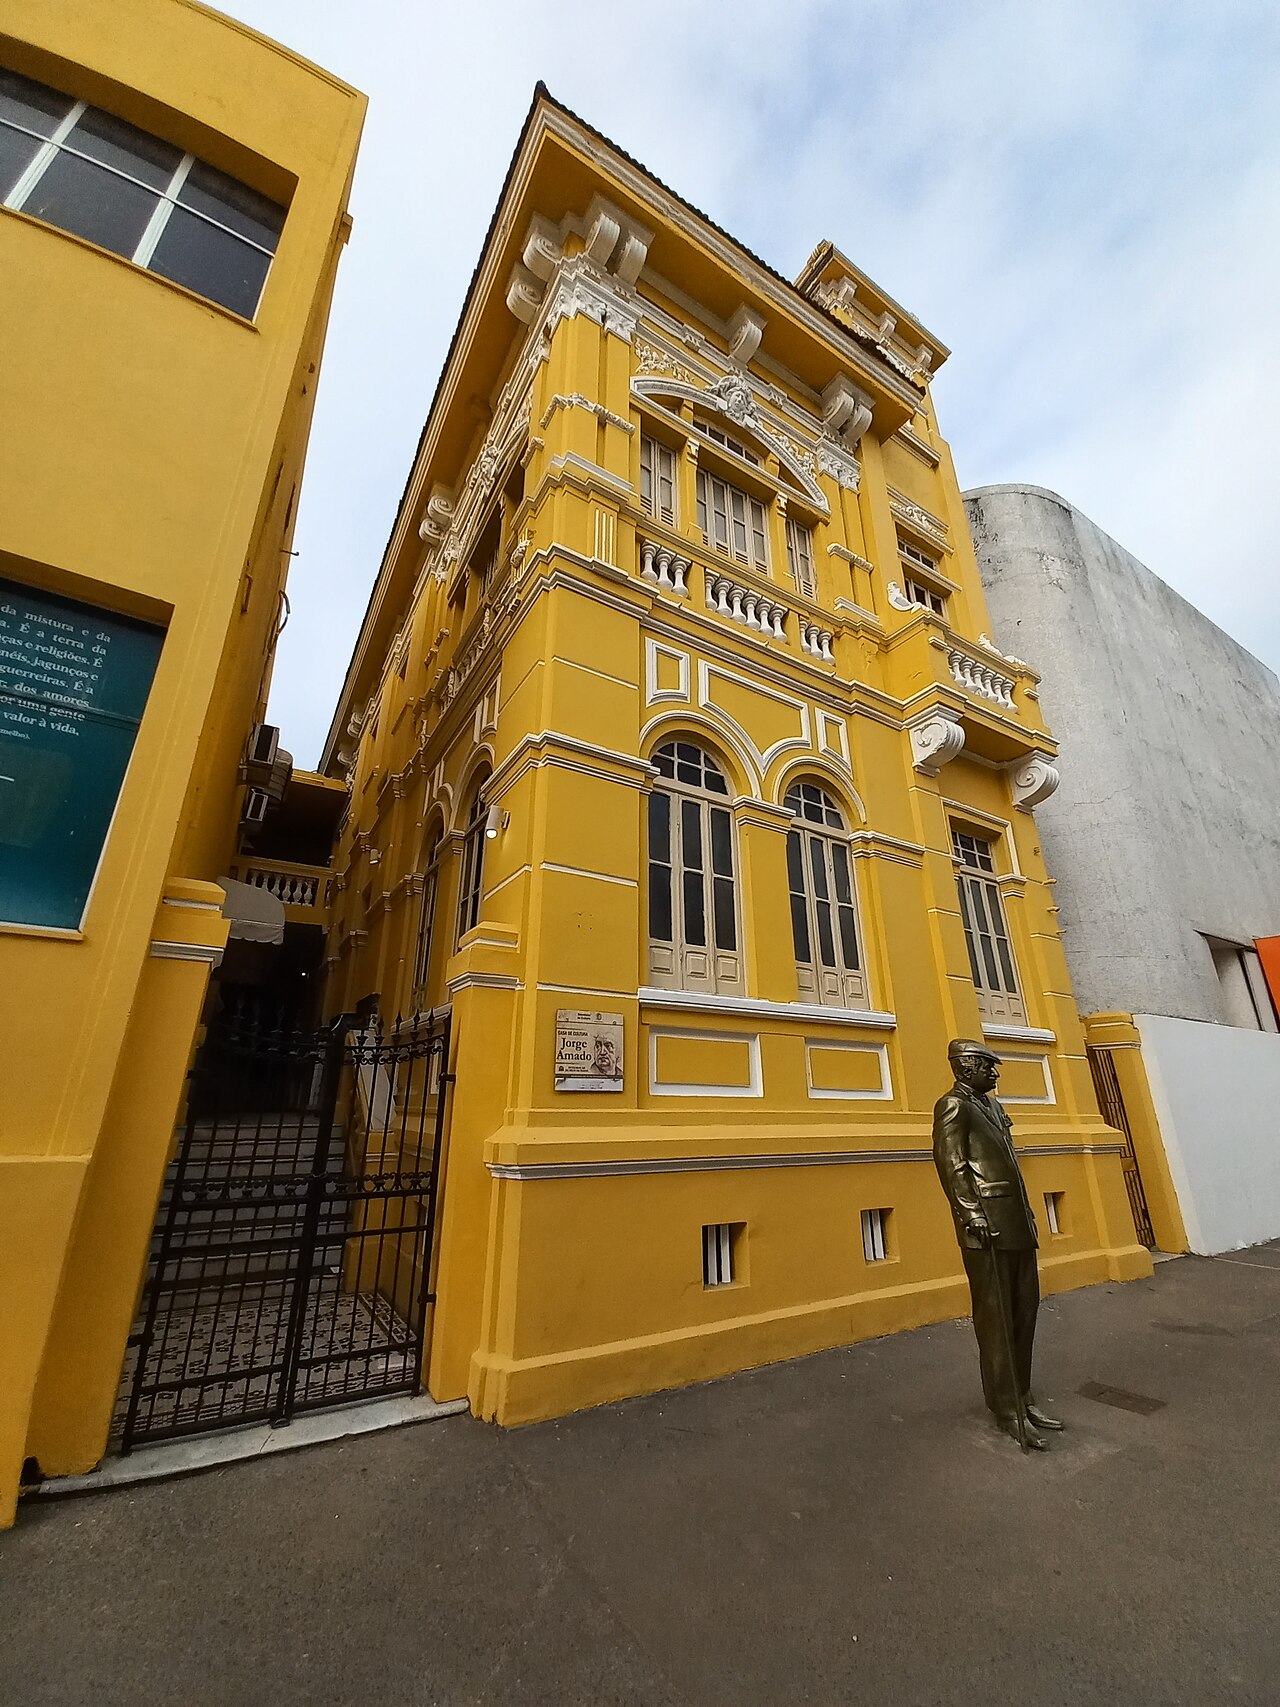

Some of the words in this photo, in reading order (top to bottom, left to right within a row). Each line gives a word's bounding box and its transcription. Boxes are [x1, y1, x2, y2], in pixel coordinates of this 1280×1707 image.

[0, 604, 17, 616] da
[24, 612, 74, 632] mistura
[96, 632, 111, 643] da
[19, 622, 30, 634] É
[36, 630, 45, 638] a
[52, 634, 84, 649] terra
[91, 644, 107, 656] da
[0, 634, 23, 646] ças
[92, 657, 103, 668] É
[90, 673, 99, 681] e
[14, 682, 37, 695] dos
[73, 680, 84, 691] É
[85, 686, 94, 695] a
[0, 695, 16, 705] or
[17, 699, 47, 713] uma
[48, 706, 86, 722] gente
[3, 711, 37, 725] valor
[38, 717, 47, 728] à
[561, 1037, 588, 1051] Jorge
[556, 1050, 592, 1061] Amado
